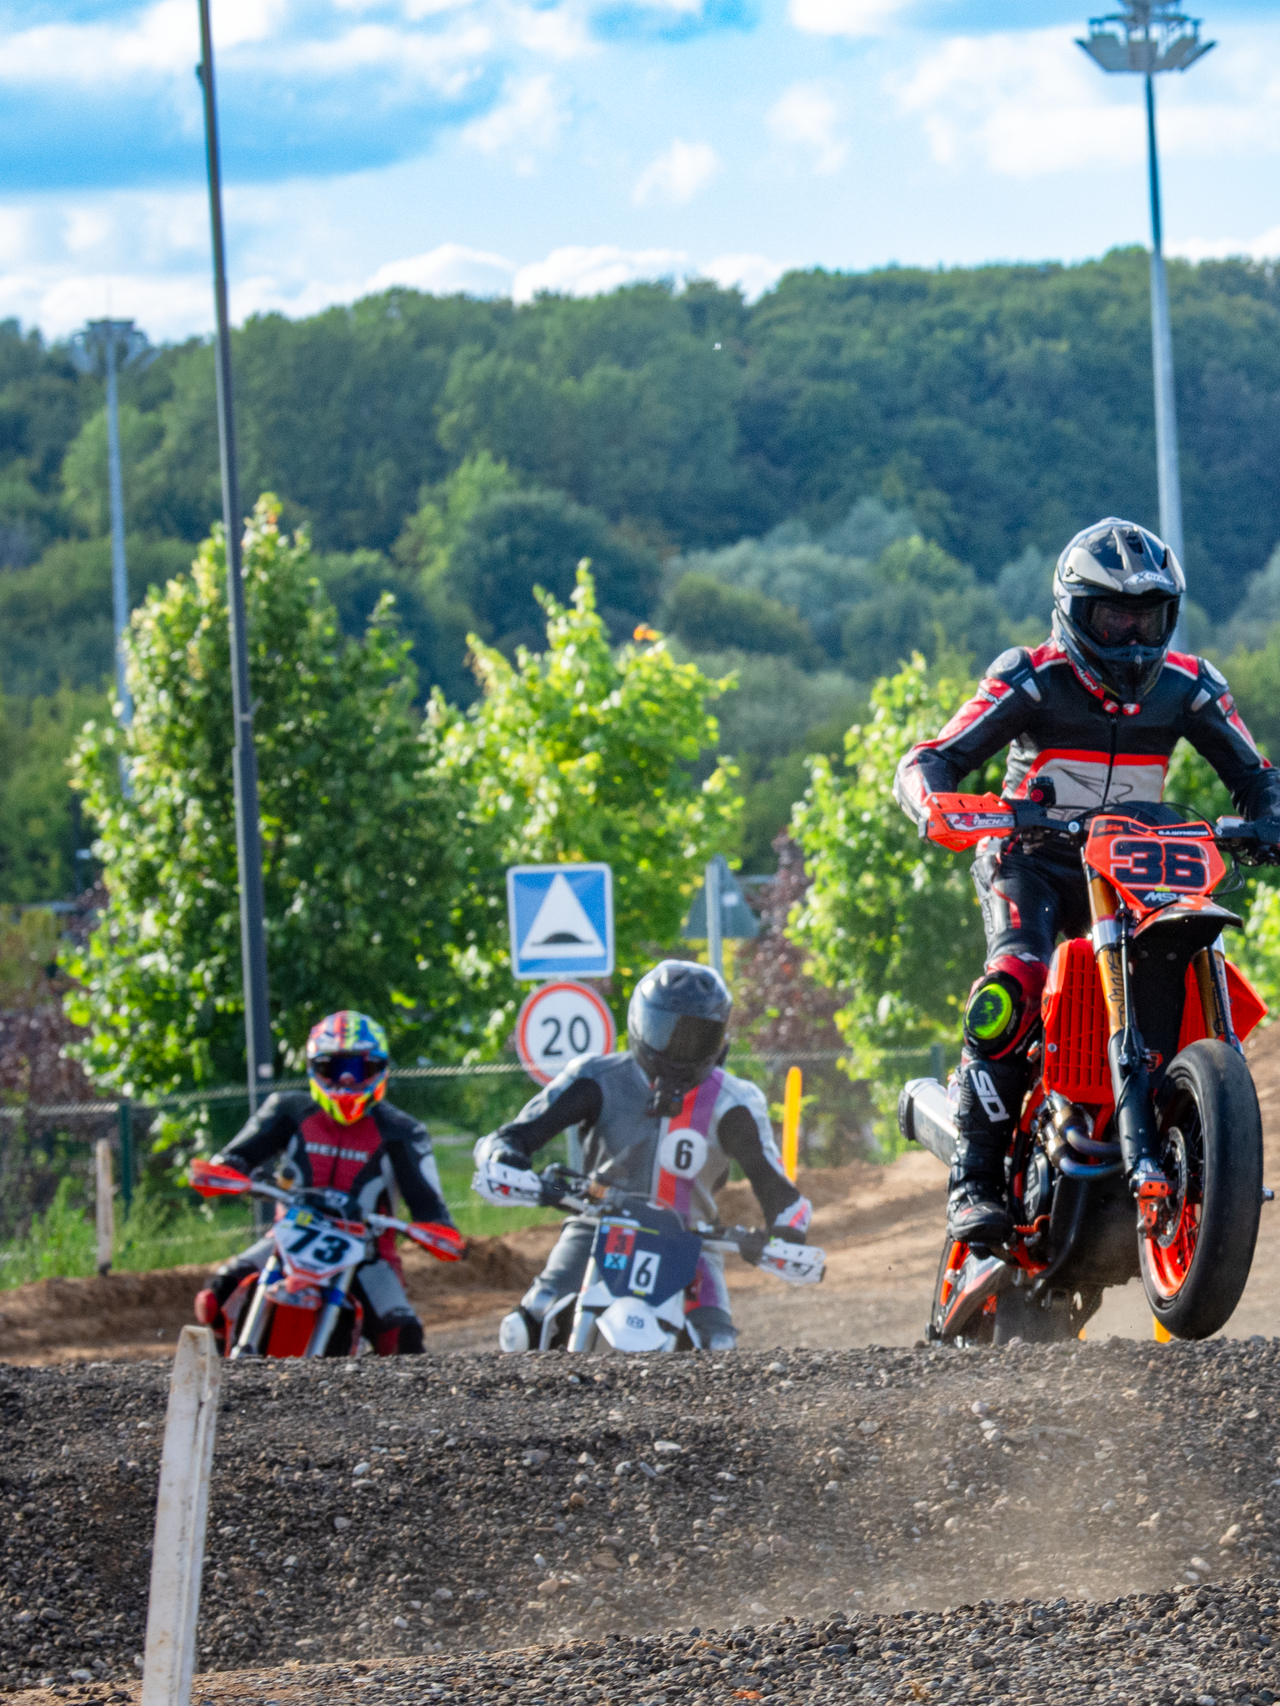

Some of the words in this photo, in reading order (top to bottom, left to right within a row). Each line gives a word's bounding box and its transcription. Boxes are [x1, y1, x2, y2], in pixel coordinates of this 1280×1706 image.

[1112, 839, 1208, 890] 36
[541, 1016, 591, 1056] 20
[674, 1138, 692, 1170] 6
[287, 1223, 352, 1264] 73
[635, 1257, 652, 1288] 6
